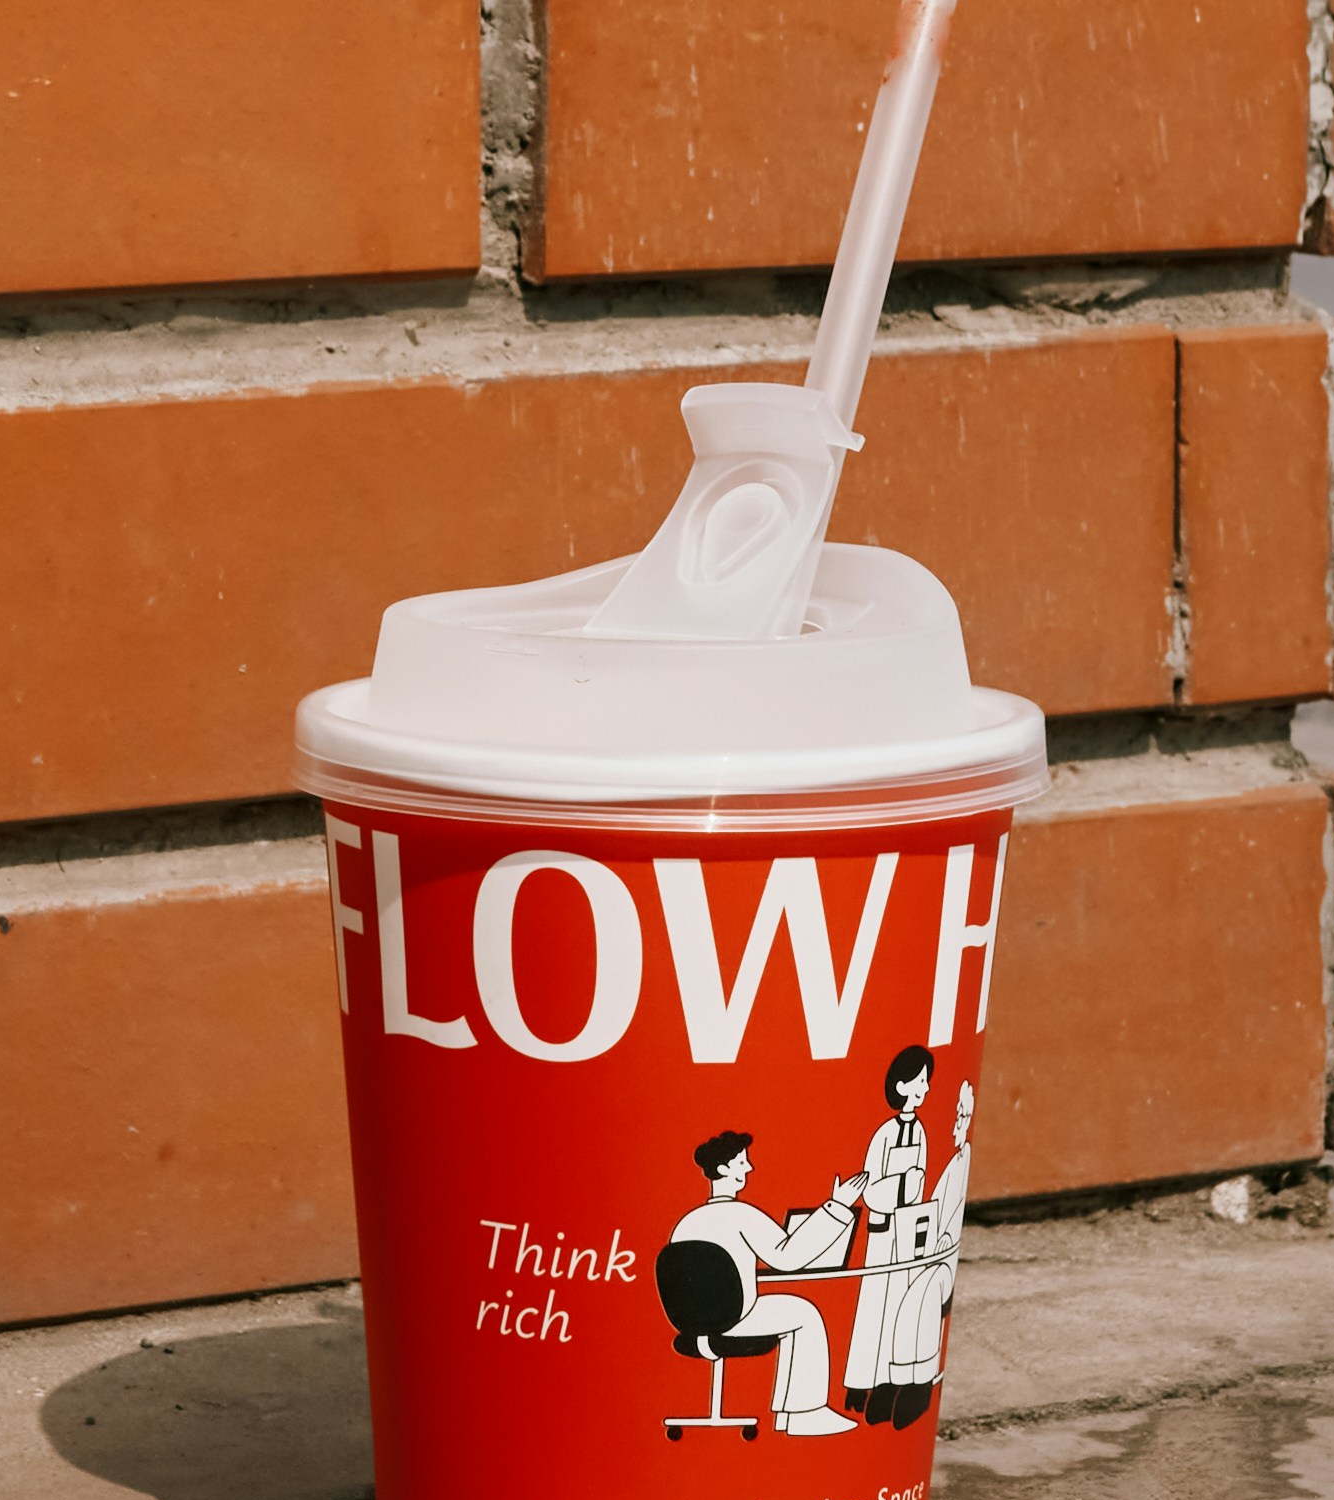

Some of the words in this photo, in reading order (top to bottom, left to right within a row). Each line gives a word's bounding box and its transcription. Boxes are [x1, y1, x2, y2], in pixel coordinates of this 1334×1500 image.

[325, 811, 900, 1064] FLOW
[479, 1218, 638, 1284] Think
[475, 1288, 573, 1344] rich
